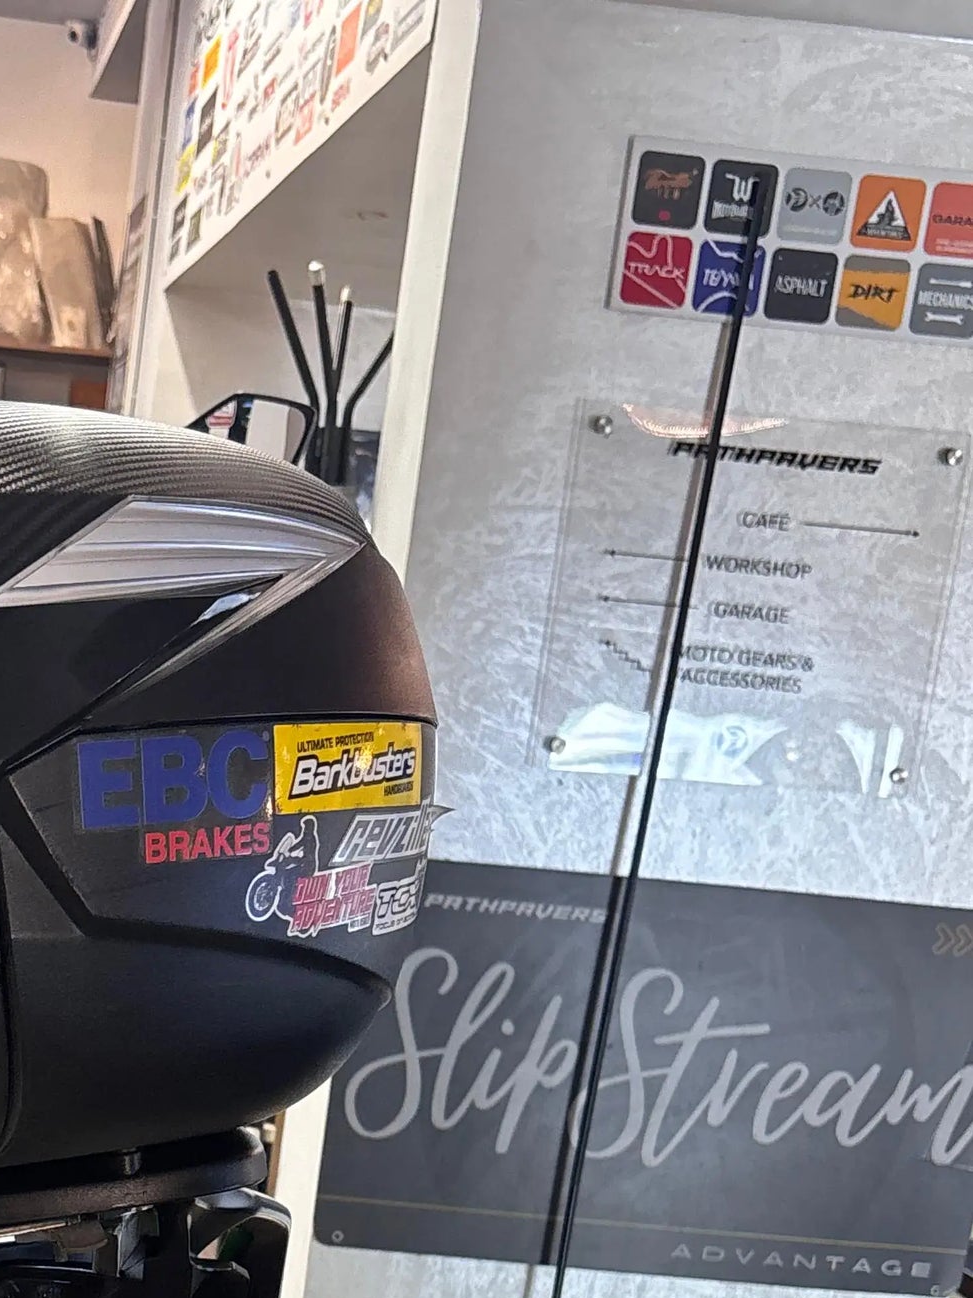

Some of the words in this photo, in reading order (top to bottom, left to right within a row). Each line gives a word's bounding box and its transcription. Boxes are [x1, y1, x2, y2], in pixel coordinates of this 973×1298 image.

[775, 274, 828, 298] ASPHALT
[849, 283, 901, 304] DIRT
[704, 554, 813, 581] WORKSHOP
[712, 601, 791, 625] GARAGE
[737, 648, 798, 671] GEARS
[680, 667, 803, 695] ACCESSORIES
[297, 737, 334, 753] ULTIMATE
[335, 731, 375, 748] PROTECTION
[78, 729, 269, 830] EBC
[290, 744, 417, 797] Barkbusters
[145, 821, 270, 865] BRAKES
[424, 893, 607, 924] PATHPAVERS
[670, 1242, 932, 1280] ADVANTAGE
